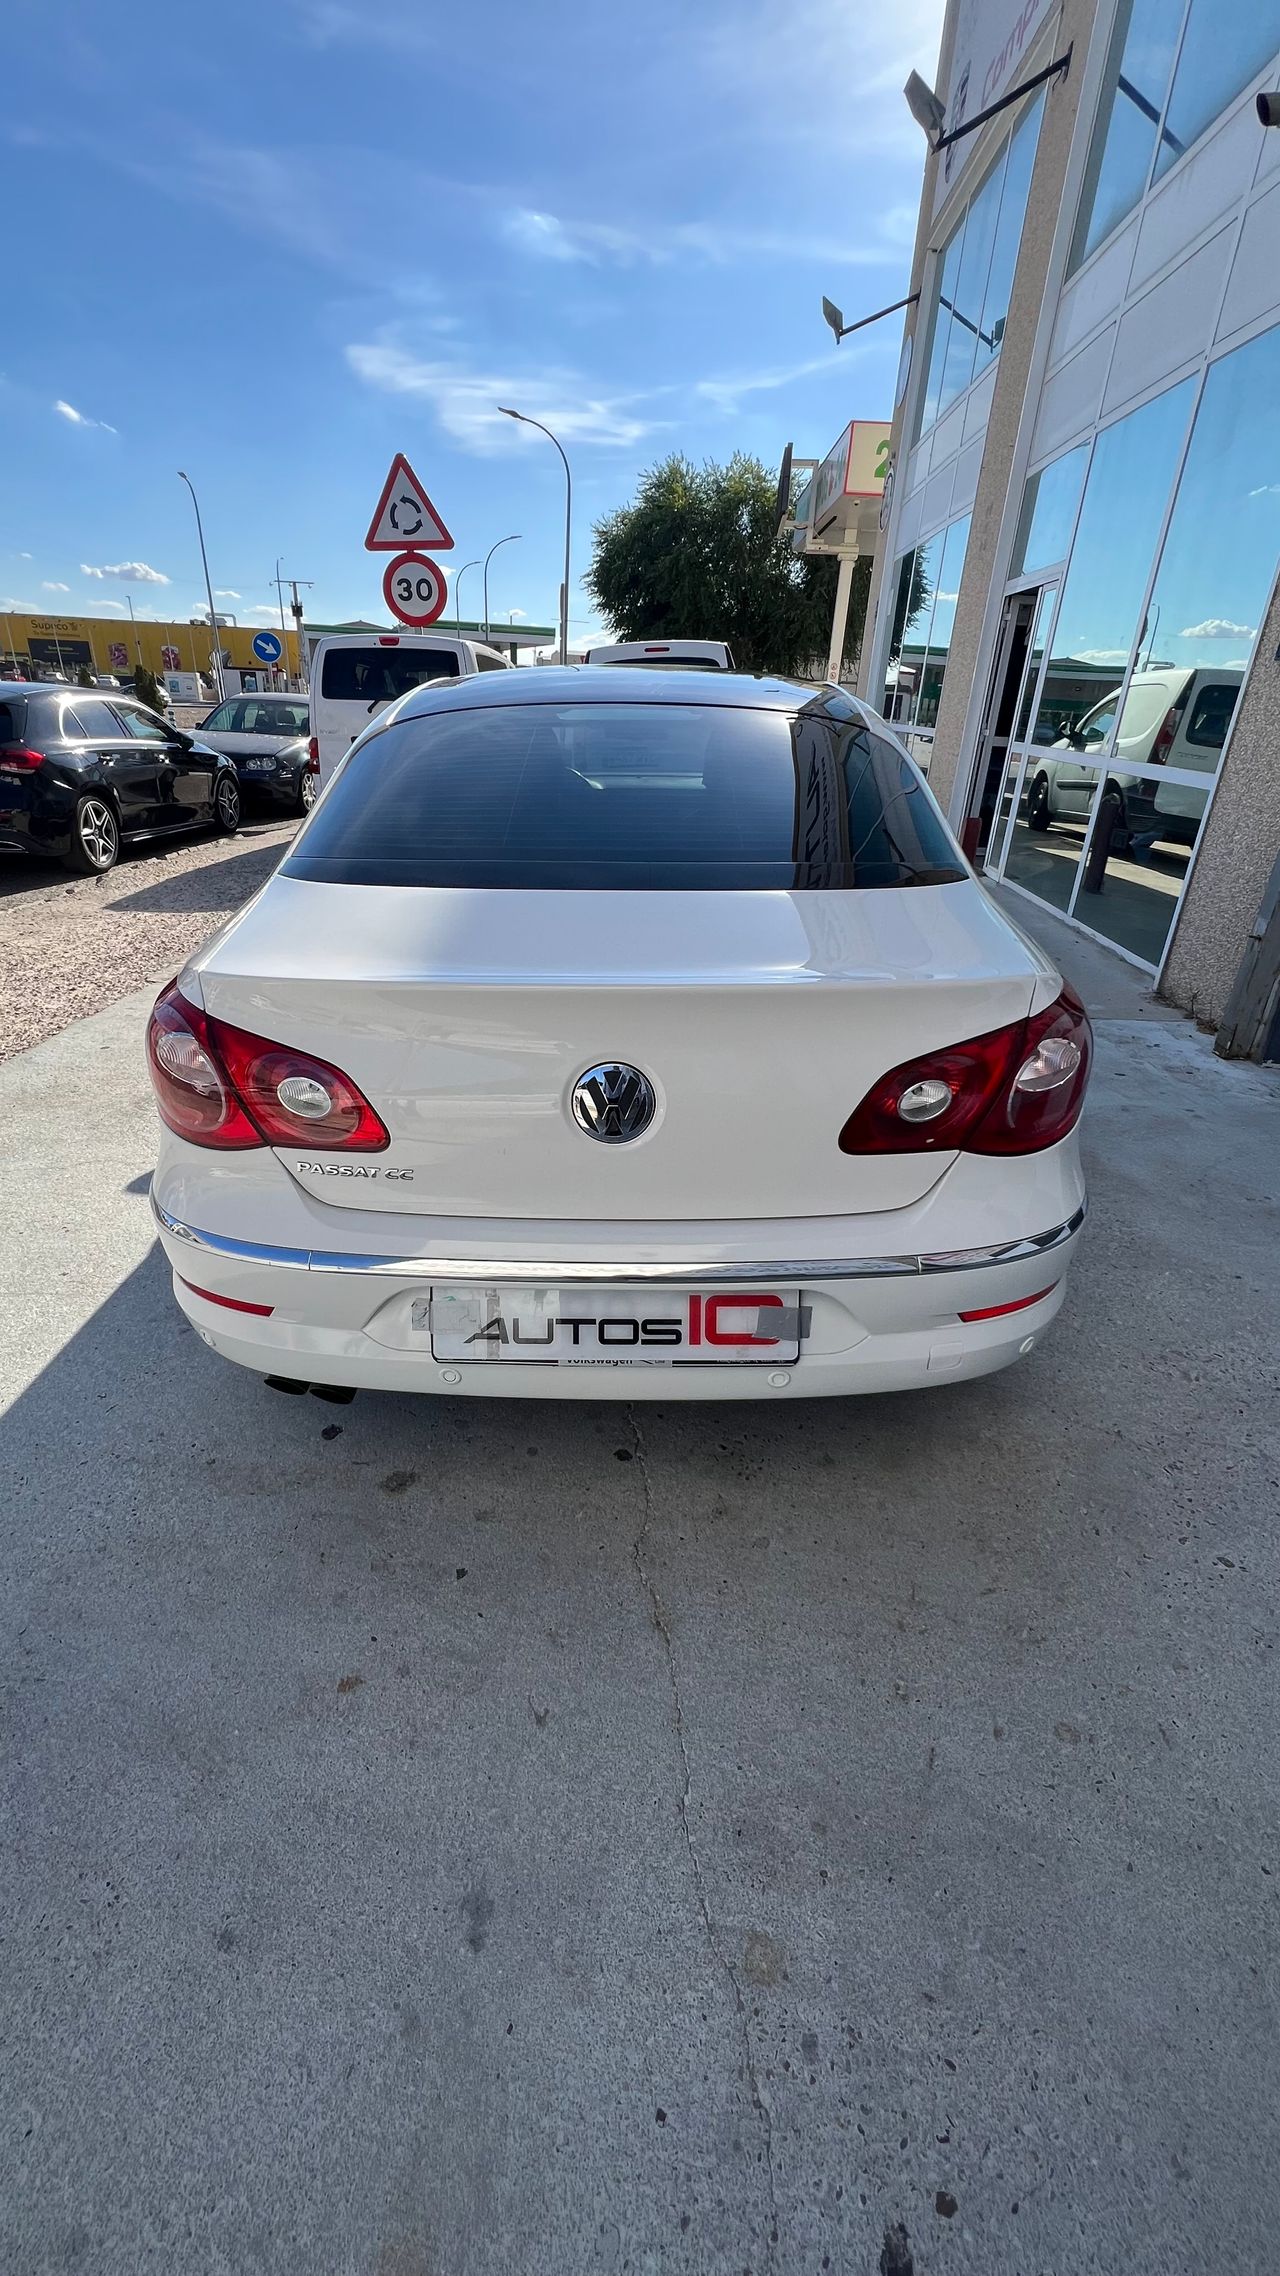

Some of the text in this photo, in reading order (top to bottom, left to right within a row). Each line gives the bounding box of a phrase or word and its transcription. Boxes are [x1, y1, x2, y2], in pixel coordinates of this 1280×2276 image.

[397, 578, 433, 602] 30
[296, 1161, 414, 1180] PASSAT CC
